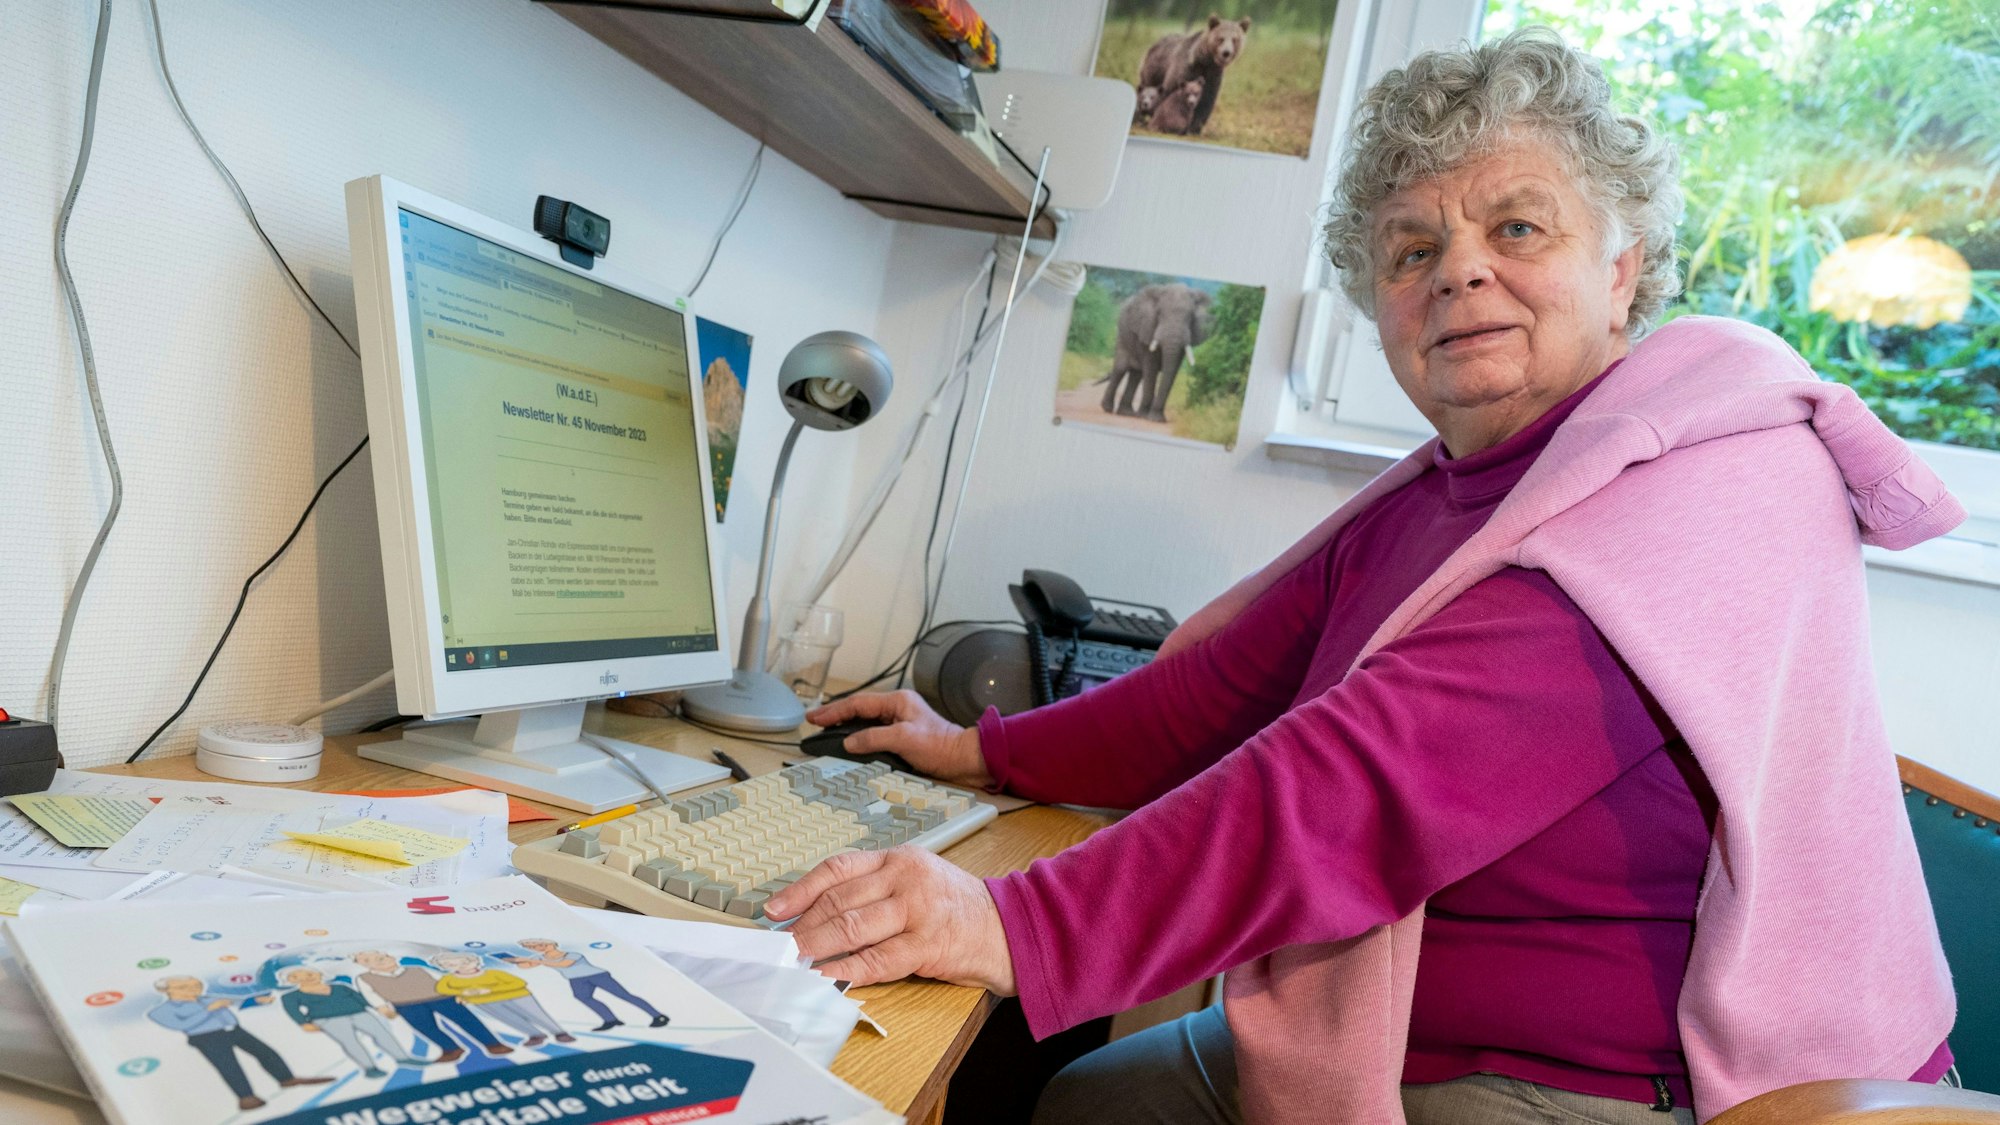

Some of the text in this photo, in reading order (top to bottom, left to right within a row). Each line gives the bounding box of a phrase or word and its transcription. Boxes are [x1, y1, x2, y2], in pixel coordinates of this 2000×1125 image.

[557, 383, 598, 407] (W.a.d.E.)
[503, 401, 646, 441] Newsletter Nr. 45 November 2023
[501, 488, 527, 500] Hamburg
[600, 672, 618, 686] FUJITSU
[462, 900, 525, 912] bagso
[325, 1061, 652, 1125] Wegweiser durch
[588, 1077, 688, 1108] Welt
